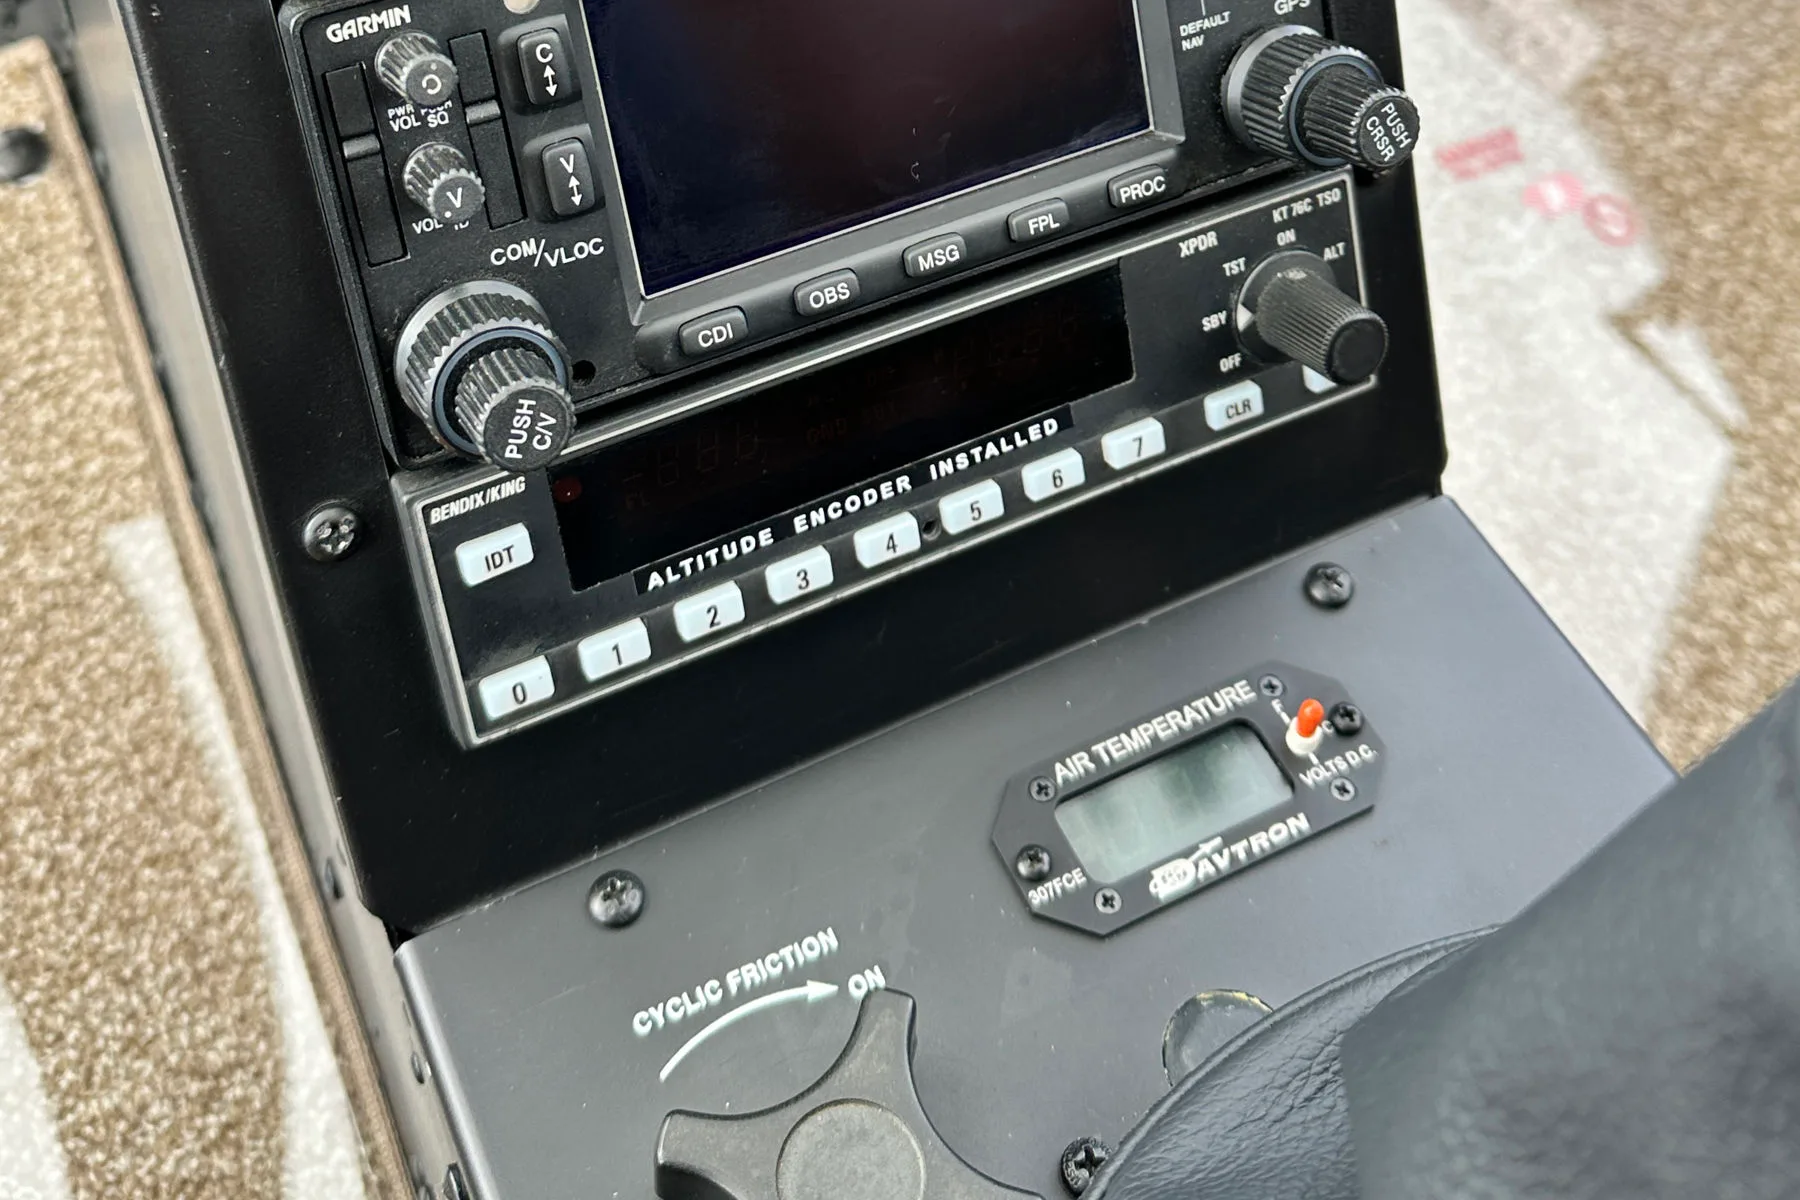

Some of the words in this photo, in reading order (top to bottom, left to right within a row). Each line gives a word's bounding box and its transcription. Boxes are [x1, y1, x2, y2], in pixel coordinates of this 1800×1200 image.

[326, 5, 411, 44] GARMIN
[1179, 11, 1231, 37] DEFAULT
[535, 43, 554, 63] C
[1181, 35, 1204, 52] NAV
[387, 103, 415, 119] PWR
[389, 114, 421, 132] VOL
[427, 111, 450, 128] SQ
[1381, 102, 1412, 148] PUSH
[1366, 116, 1395, 162] CRSR
[559, 154, 575, 174] V
[446, 187, 463, 209] V
[1119, 175, 1166, 203] PROC
[1272, 205, 1289, 223] KT
[1290, 197, 1313, 217] 76C
[1316, 188, 1341, 207] TSO
[412, 217, 443, 235] VOL
[1027, 212, 1061, 236] FPL
[1178, 231, 1218, 258] XPDR
[1277, 228, 1296, 246] ON
[490, 236, 605, 268] COM/VLOC
[917, 244, 961, 272] MSG
[1323, 242, 1346, 261] ALT
[1222, 257, 1247, 277] TST
[808, 281, 851, 310] OBS
[1201, 310, 1227, 332] SBY
[697, 321, 734, 349] CDI
[1219, 353, 1242, 373] OFF
[1225, 397, 1251, 420] CLR
[505, 398, 537, 460] PUSH
[532, 412, 557, 451] C/V
[1132, 436, 1145, 458] 7
[1051, 468, 1064, 490] 6
[430, 476, 526, 525] BENDIX/KING
[646, 527, 774, 591] ALTITUDE
[792, 474, 912, 534] ENCODER
[929, 416, 1059, 482] INSTALLED
[969, 501, 983, 523] 5
[885, 532, 899, 554] 4
[484, 544, 514, 572] IDT
[796, 568, 810, 591] 3
[705, 605, 720, 628] 2
[611, 644, 622, 666] 1
[512, 682, 527, 704] 0
[1054, 752, 1096, 787] AIR
[1091, 678, 1258, 767] TEMPERATURE
[1299, 756, 1349, 789] VOLTS
[633, 978, 723, 1037] CYCLIC
[726, 926, 839, 996] FRICTION
[848, 964, 886, 1001] ON
